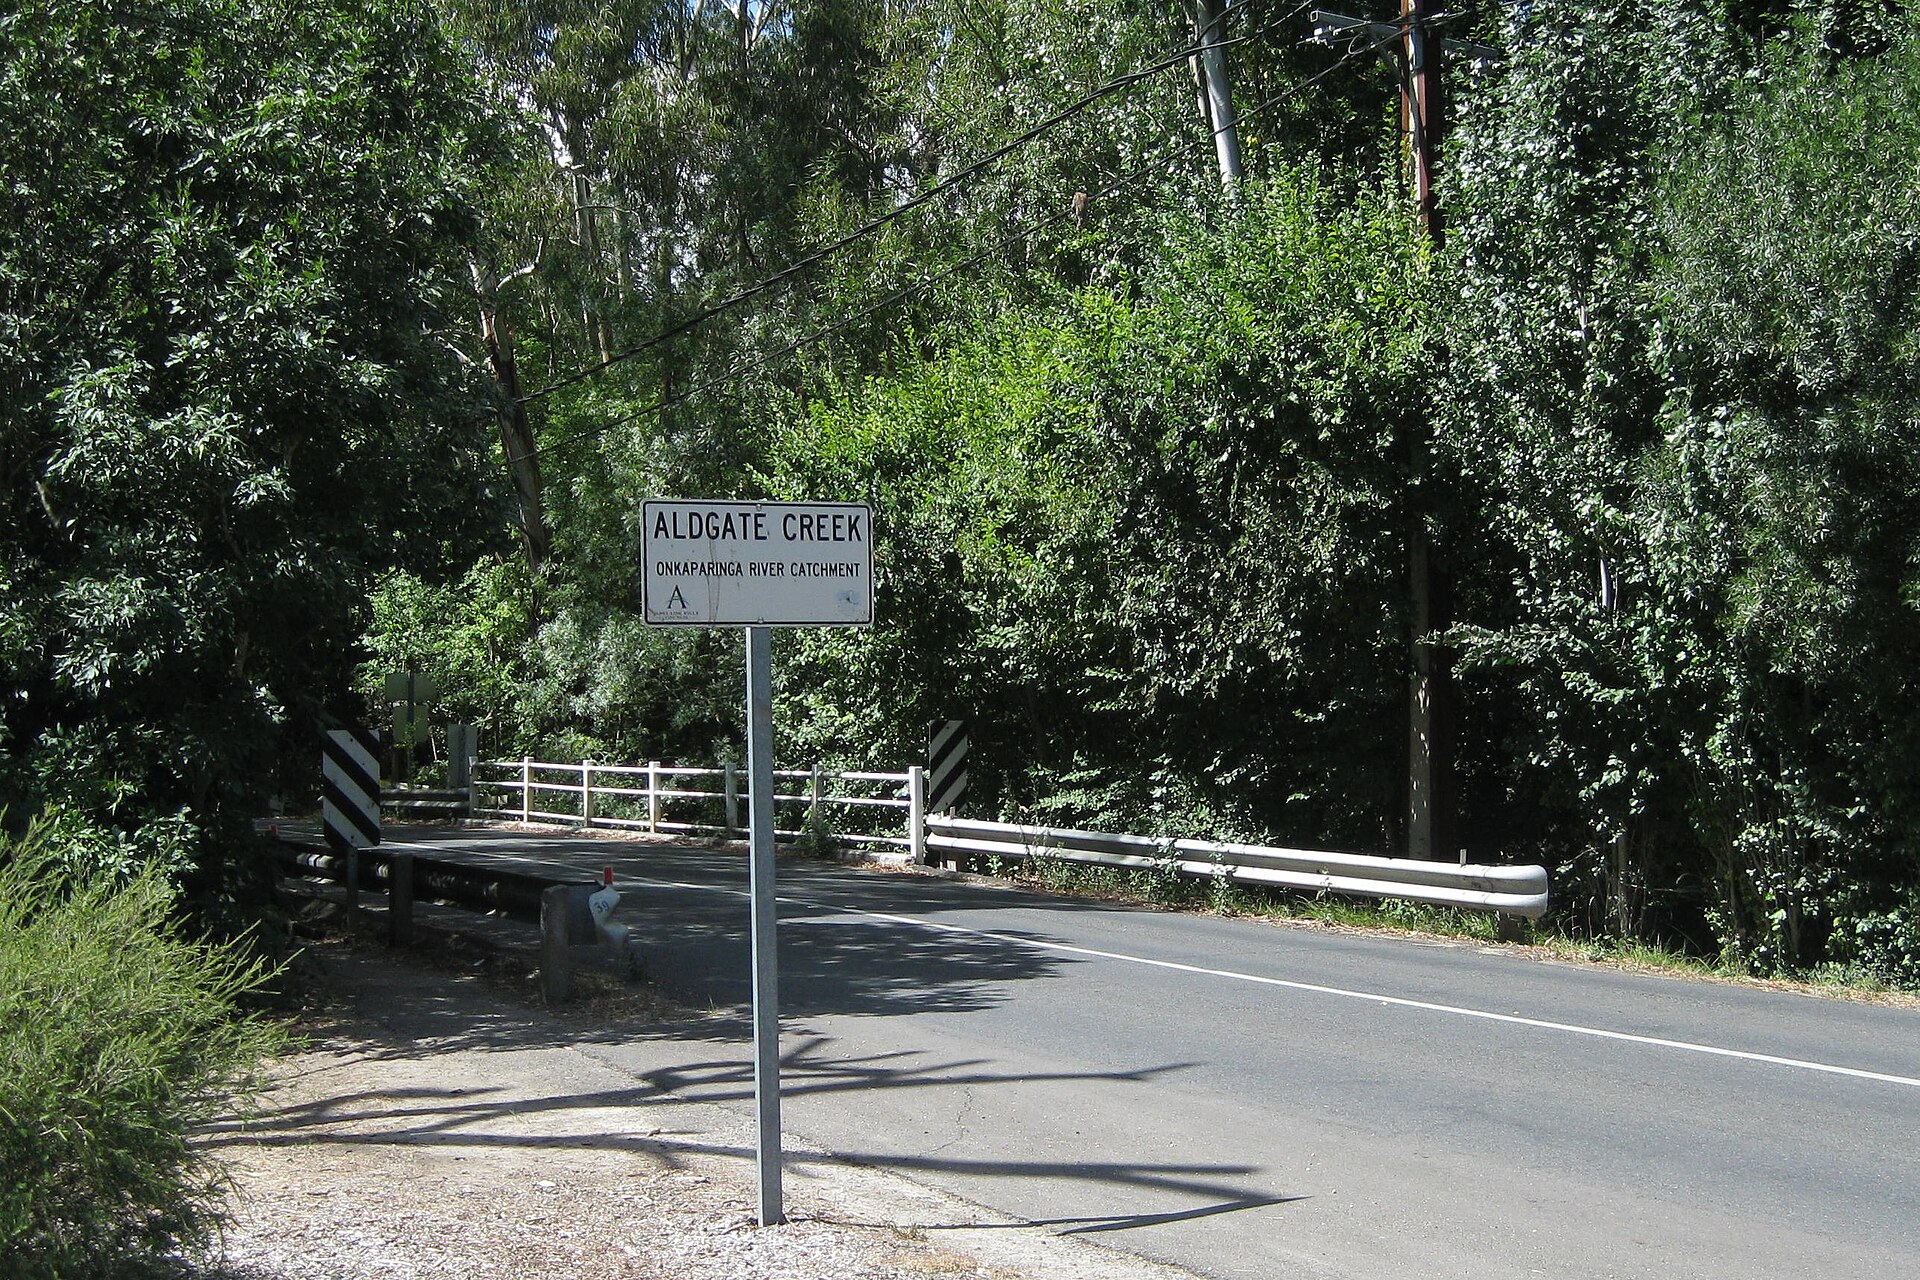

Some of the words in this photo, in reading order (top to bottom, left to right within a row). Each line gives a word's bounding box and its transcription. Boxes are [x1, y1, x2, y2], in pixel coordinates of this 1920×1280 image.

[654, 511, 768, 540] ALDGATE
[783, 513, 862, 541] CREEK
[656, 561, 743, 577] ONKAPARINGA
[750, 562, 784, 577] RIVER
[791, 562, 861, 577] CATCHMENT
[668, 584, 687, 609] A
